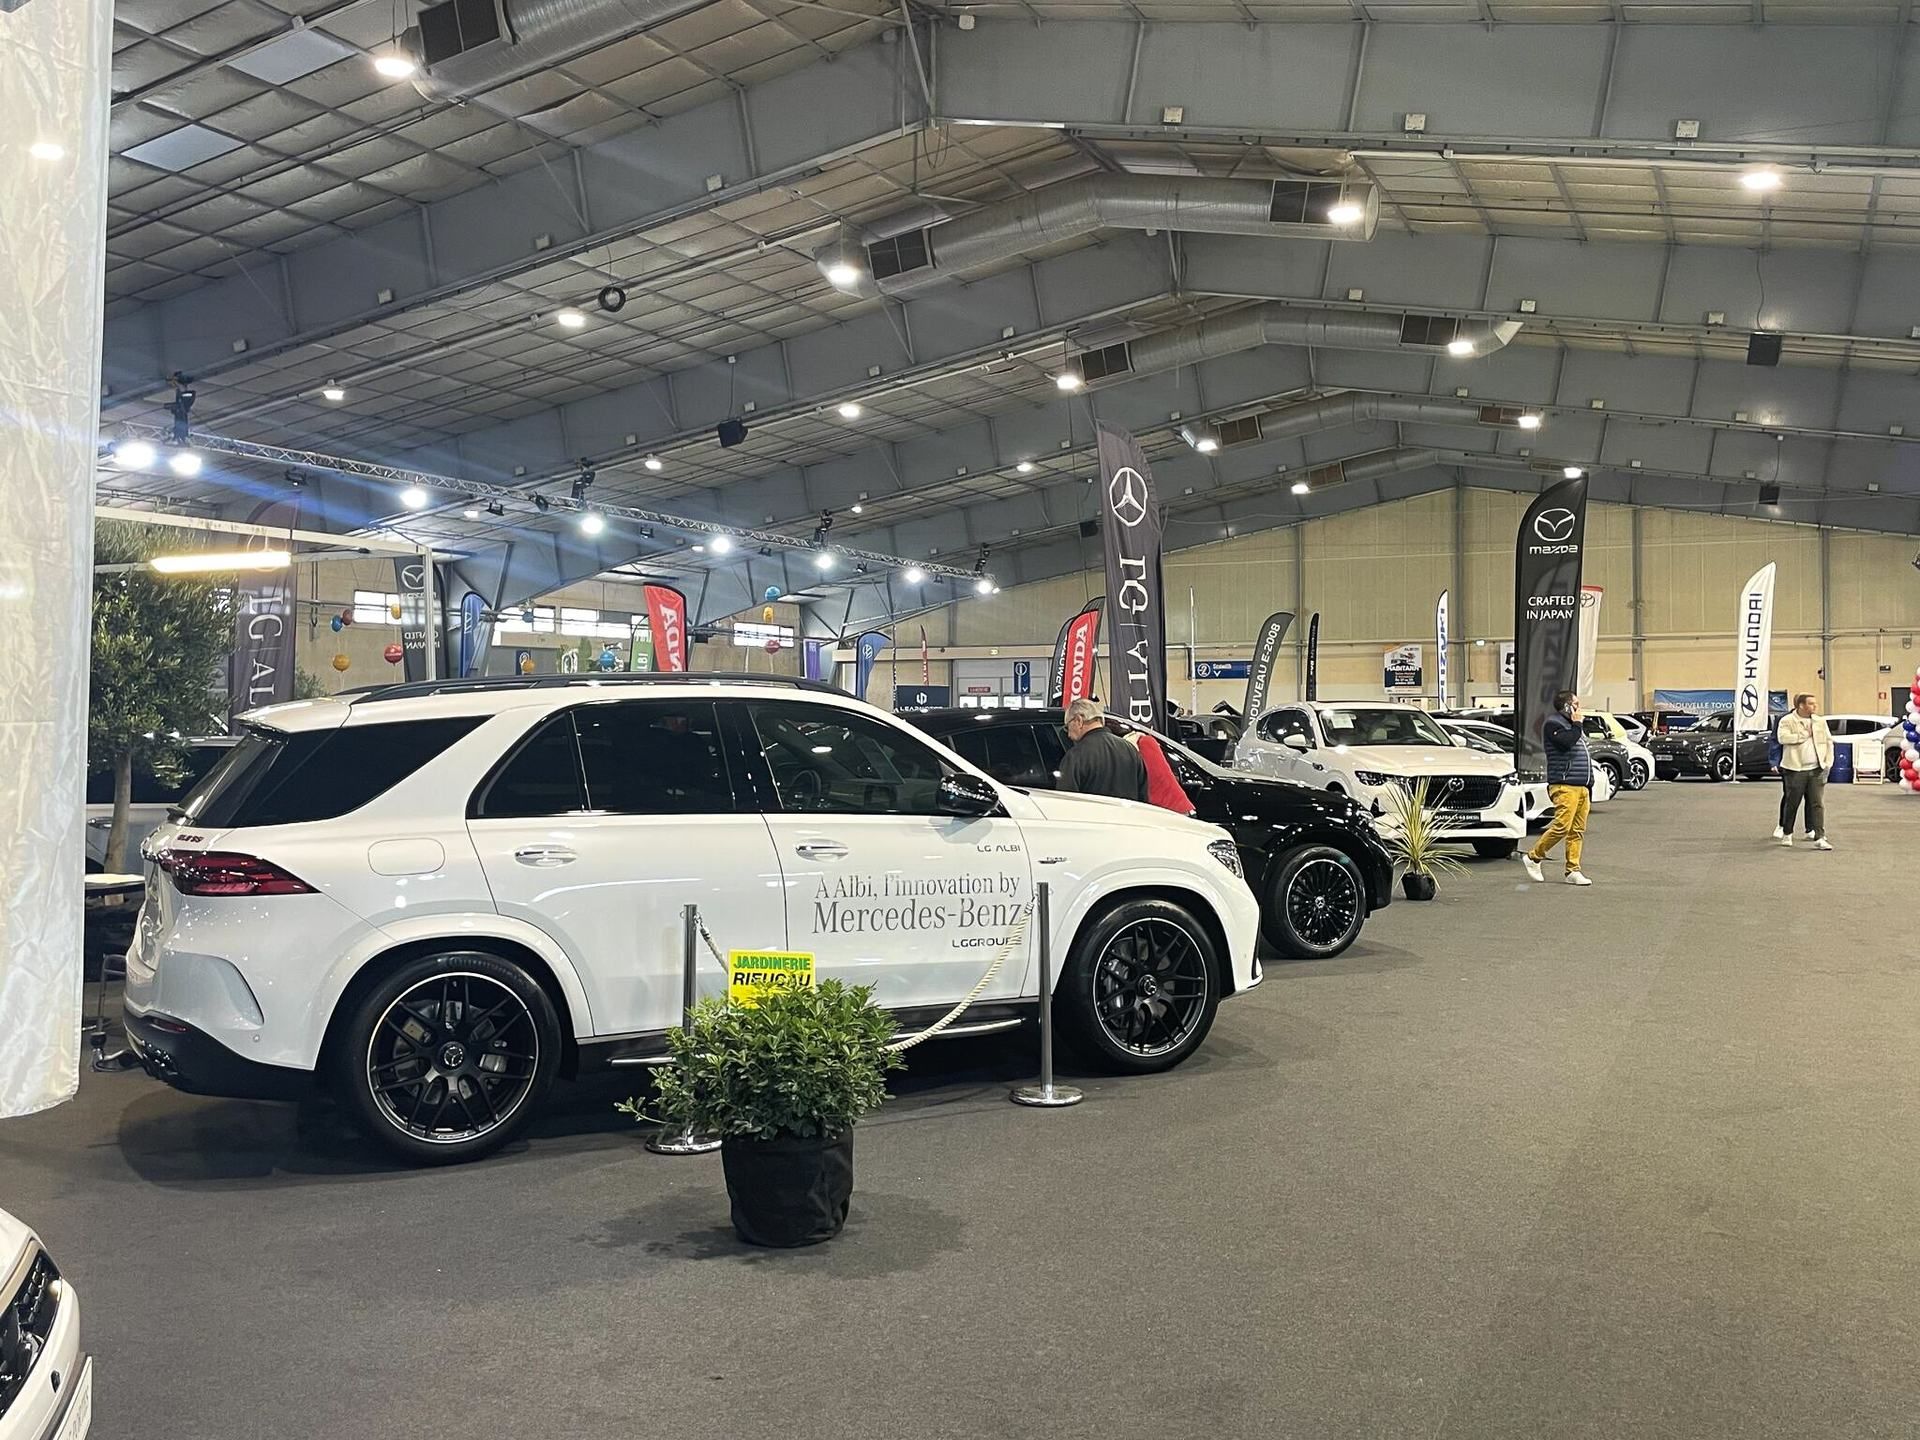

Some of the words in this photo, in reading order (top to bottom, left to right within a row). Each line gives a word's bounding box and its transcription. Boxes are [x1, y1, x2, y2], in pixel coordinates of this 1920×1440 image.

[1529, 544, 1578, 554] mazda
[1527, 595, 1575, 606] CRAFTED
[248, 595, 283, 641] LG
[1526, 609, 1539, 620] IN
[1539, 609, 1574, 621] JAPAN
[1261, 622, 1281, 664] E-2008
[1744, 593, 1762, 678] HYUNDAI
[637, 653, 648, 671] LBI
[249, 658, 276, 706] AL
[815, 877, 829, 899] A
[833, 875, 878, 900] Albi,
[885, 873, 993, 897] l'innovation
[1000, 871, 1020, 897] by
[812, 898, 1021, 933] Mercedes-Benz
[952, 937, 1021, 948] LGGROUP
[733, 956, 811, 970] JARDINERIE
[733, 972, 811, 987] RIEUCU
